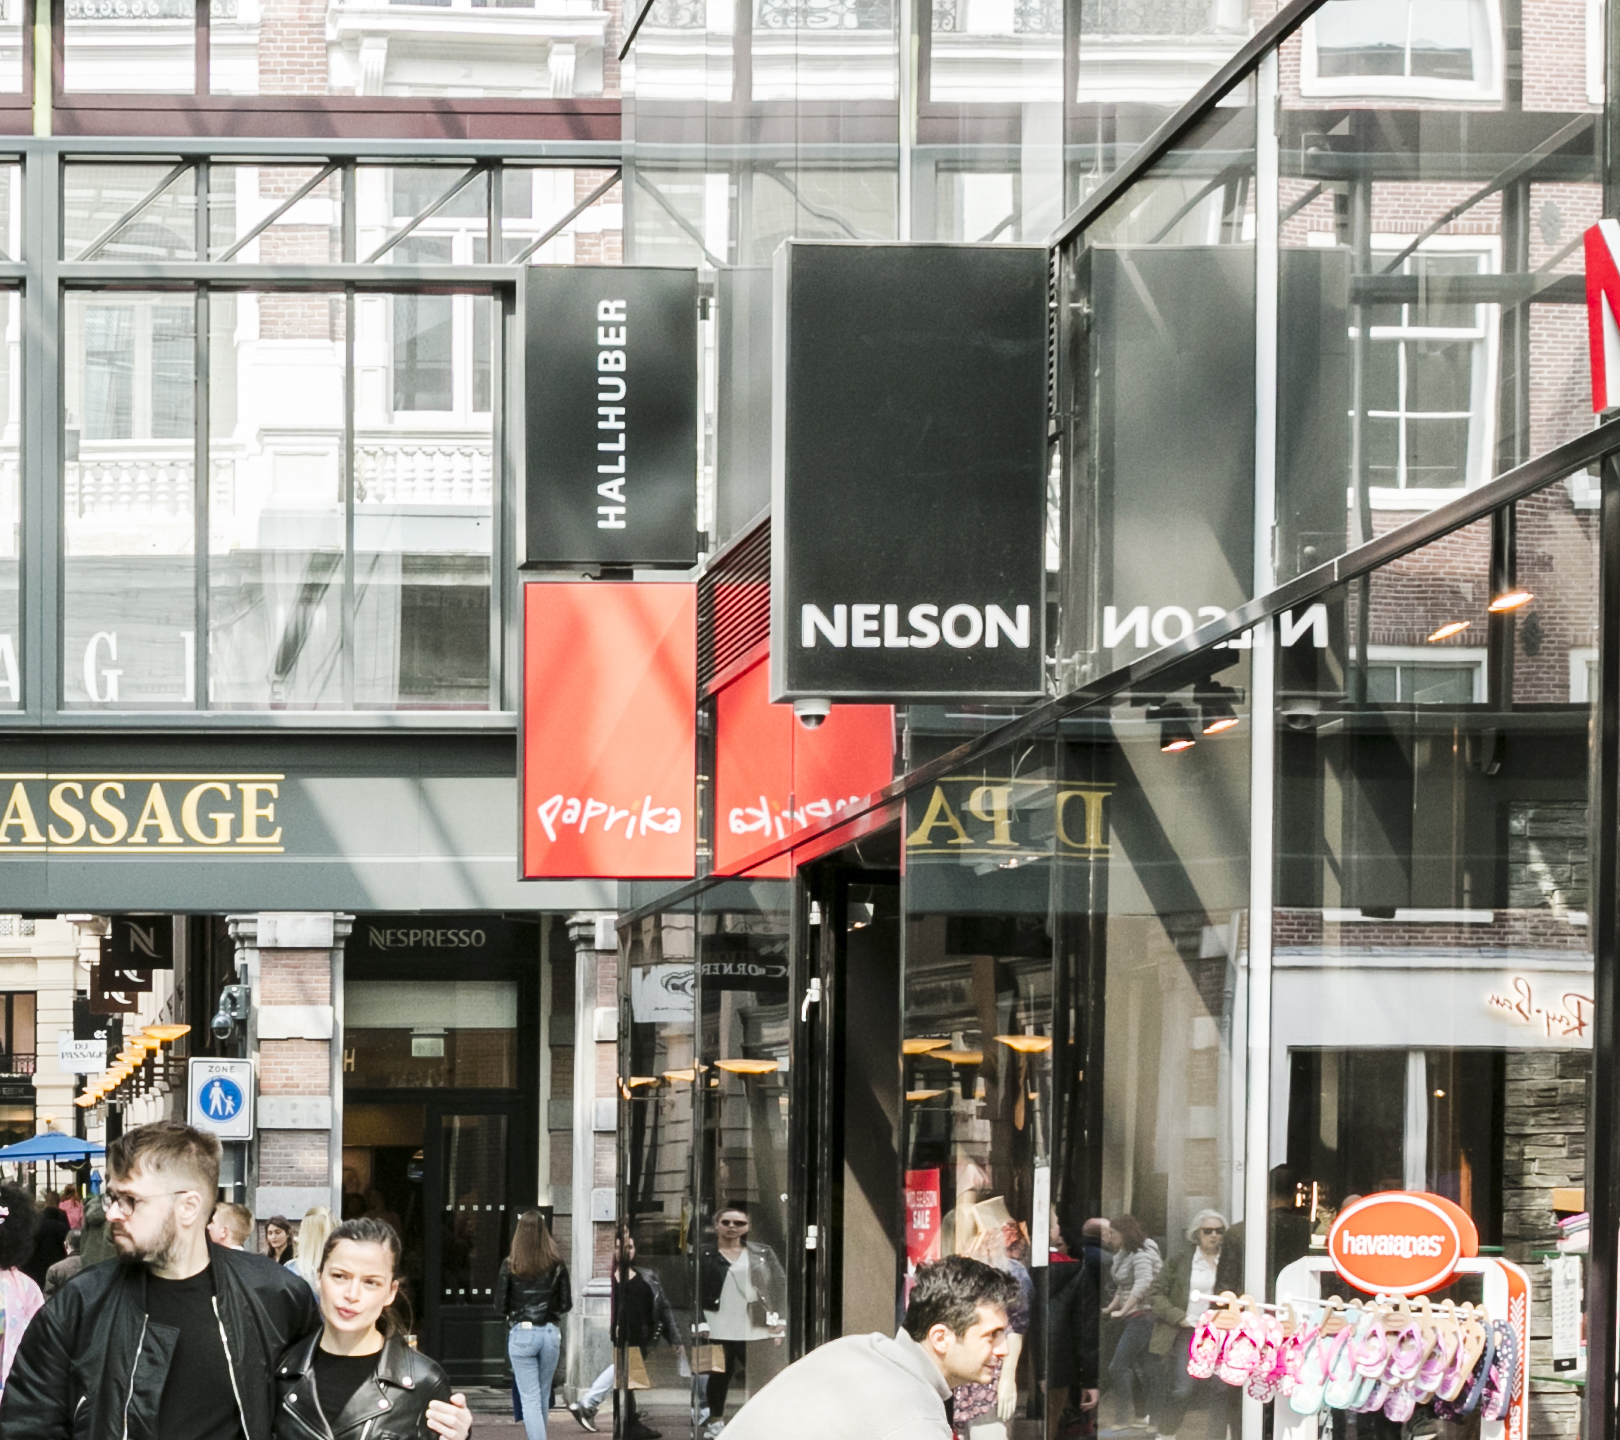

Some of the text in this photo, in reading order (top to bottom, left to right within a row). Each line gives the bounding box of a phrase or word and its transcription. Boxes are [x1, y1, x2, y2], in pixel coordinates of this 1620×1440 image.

[596, 298, 627, 530] HALLHUBER
[800, 603, 1031, 649] NELSON
[368, 924, 487, 951] NESPRESSO
[207, 1065, 236, 1074] ZONE
[912, 1209, 931, 1230] SALE
[1342, 1229, 1444, 1258] havaianas
